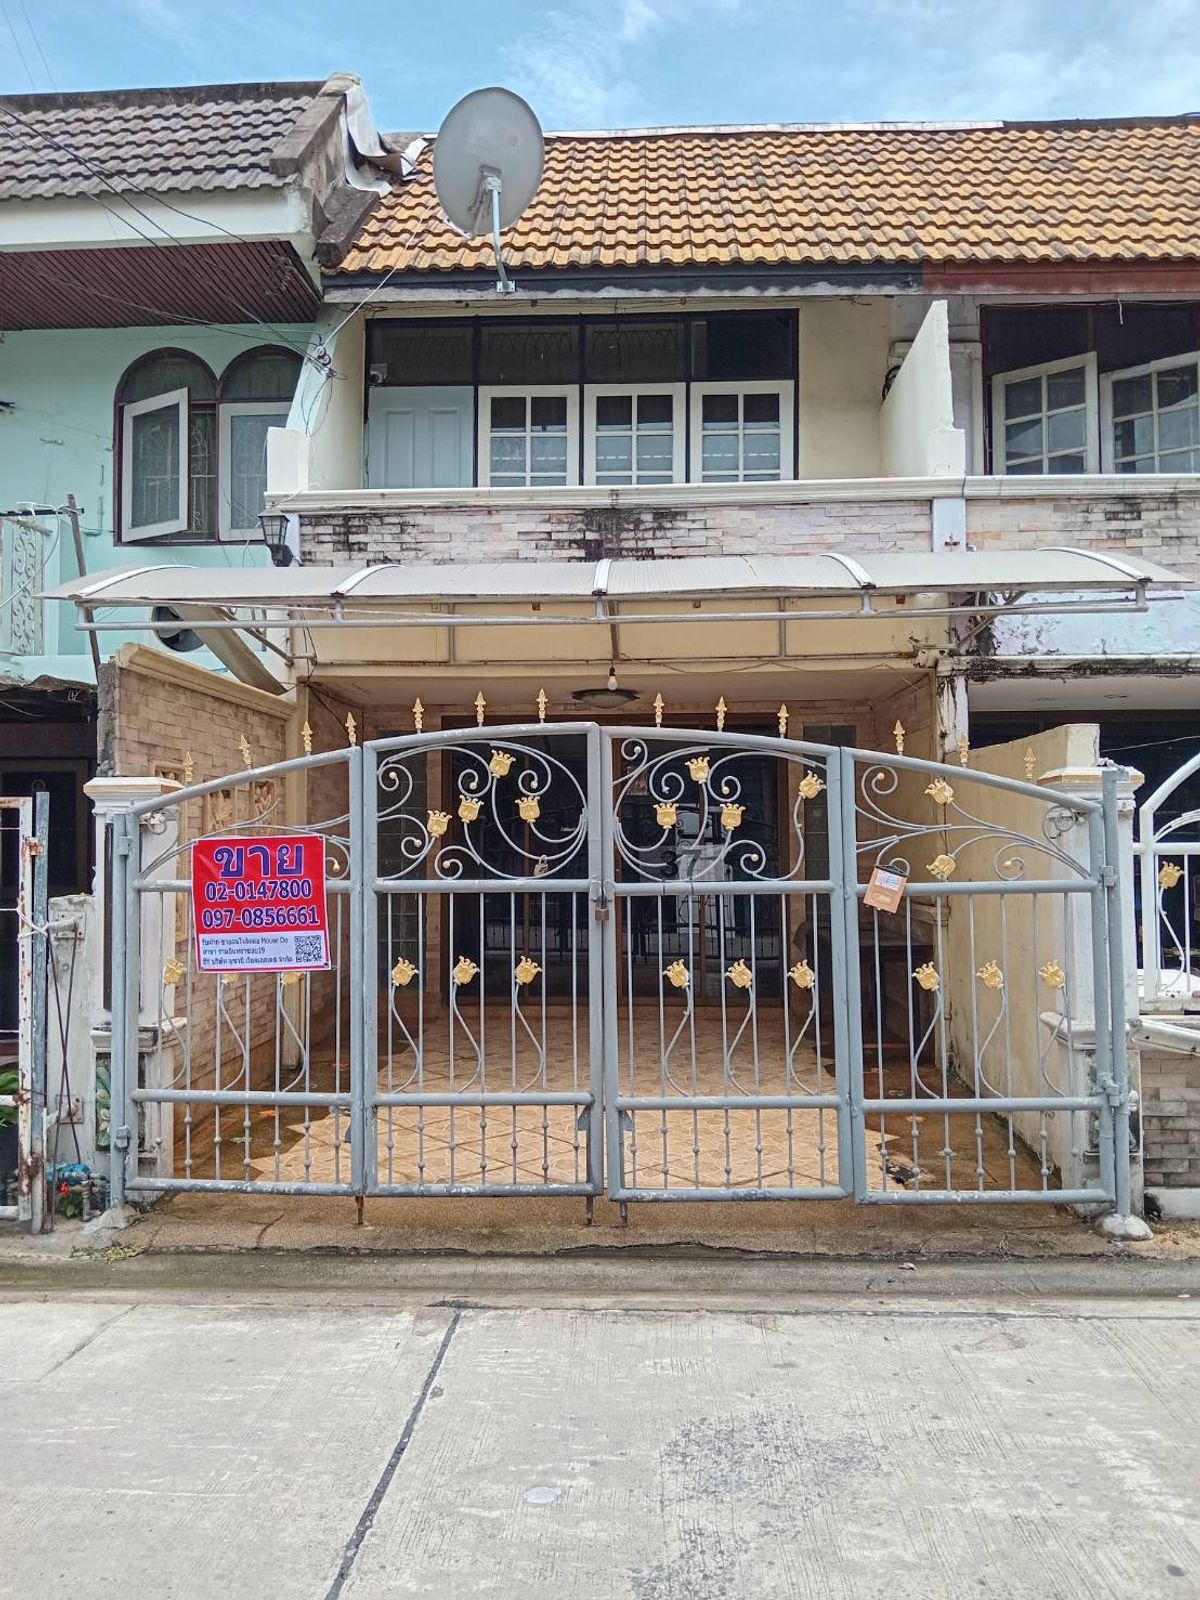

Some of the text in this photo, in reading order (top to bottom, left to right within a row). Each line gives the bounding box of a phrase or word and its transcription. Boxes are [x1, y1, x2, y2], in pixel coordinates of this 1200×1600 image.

[214, 844, 304, 878] ขาย
[206, 880, 312, 902] 02-0147800
[203, 906, 319, 928] 097-0856661
